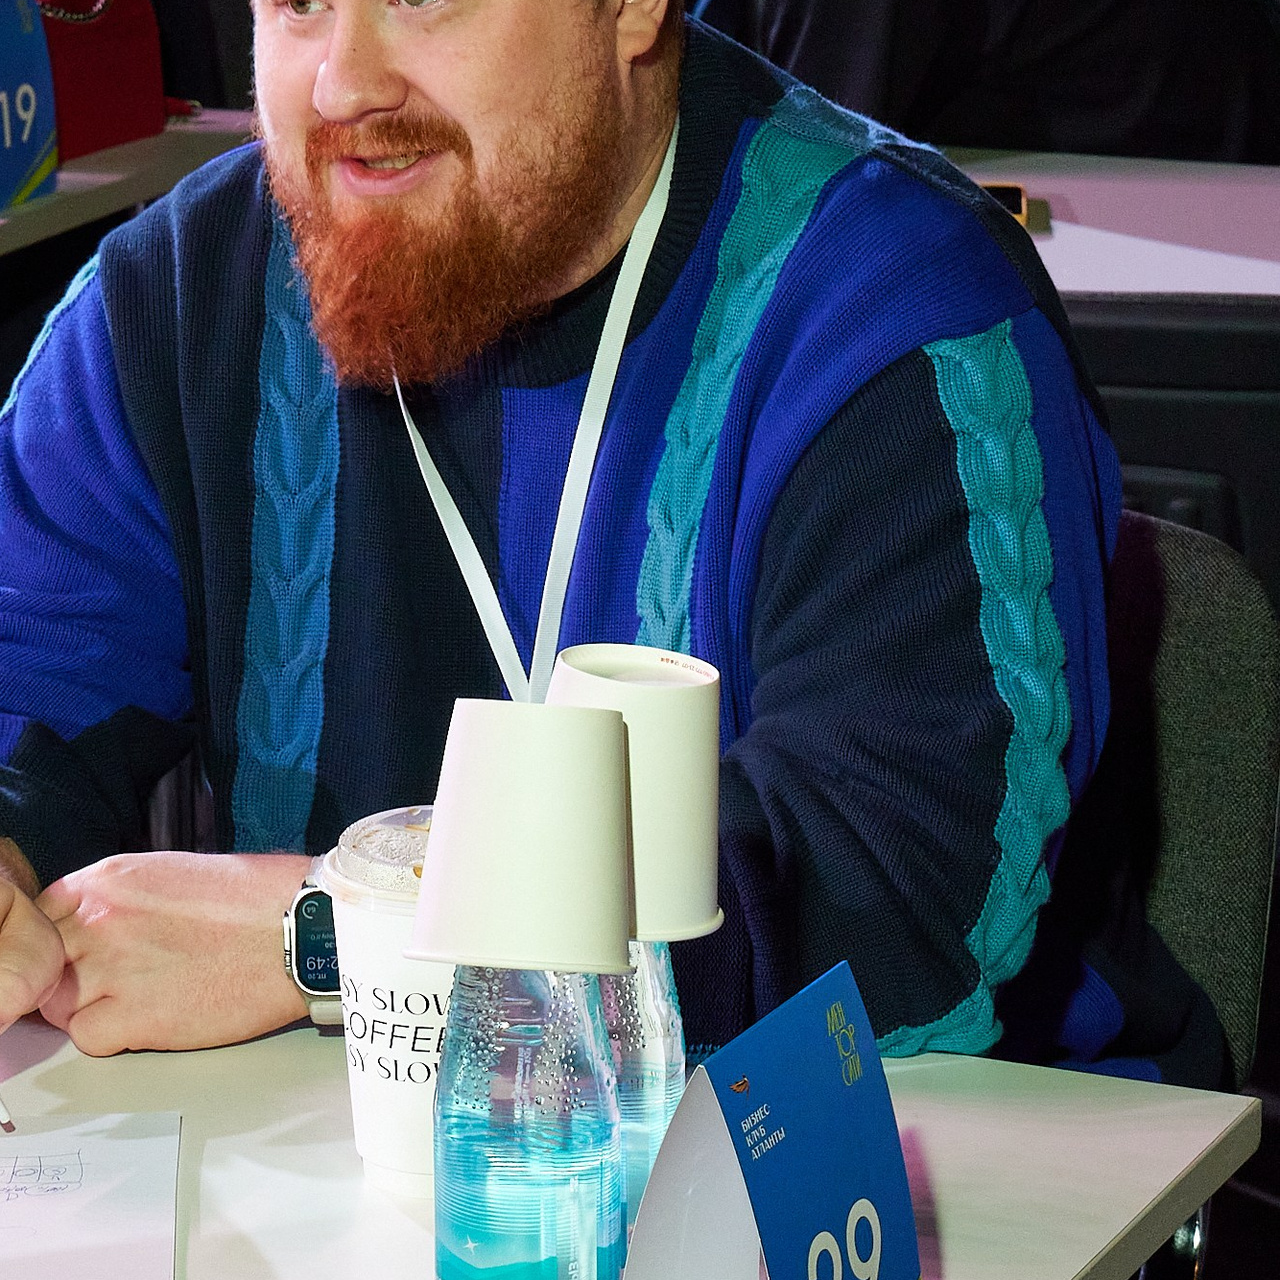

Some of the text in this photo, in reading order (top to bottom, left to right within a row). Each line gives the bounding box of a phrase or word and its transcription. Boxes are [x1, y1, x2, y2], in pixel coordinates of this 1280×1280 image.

[377, 1056, 439, 1084] SLO
[745, 1124, 767, 1148] КЛУБ
[751, 1127, 786, 1162] АТЛАНТЫ
